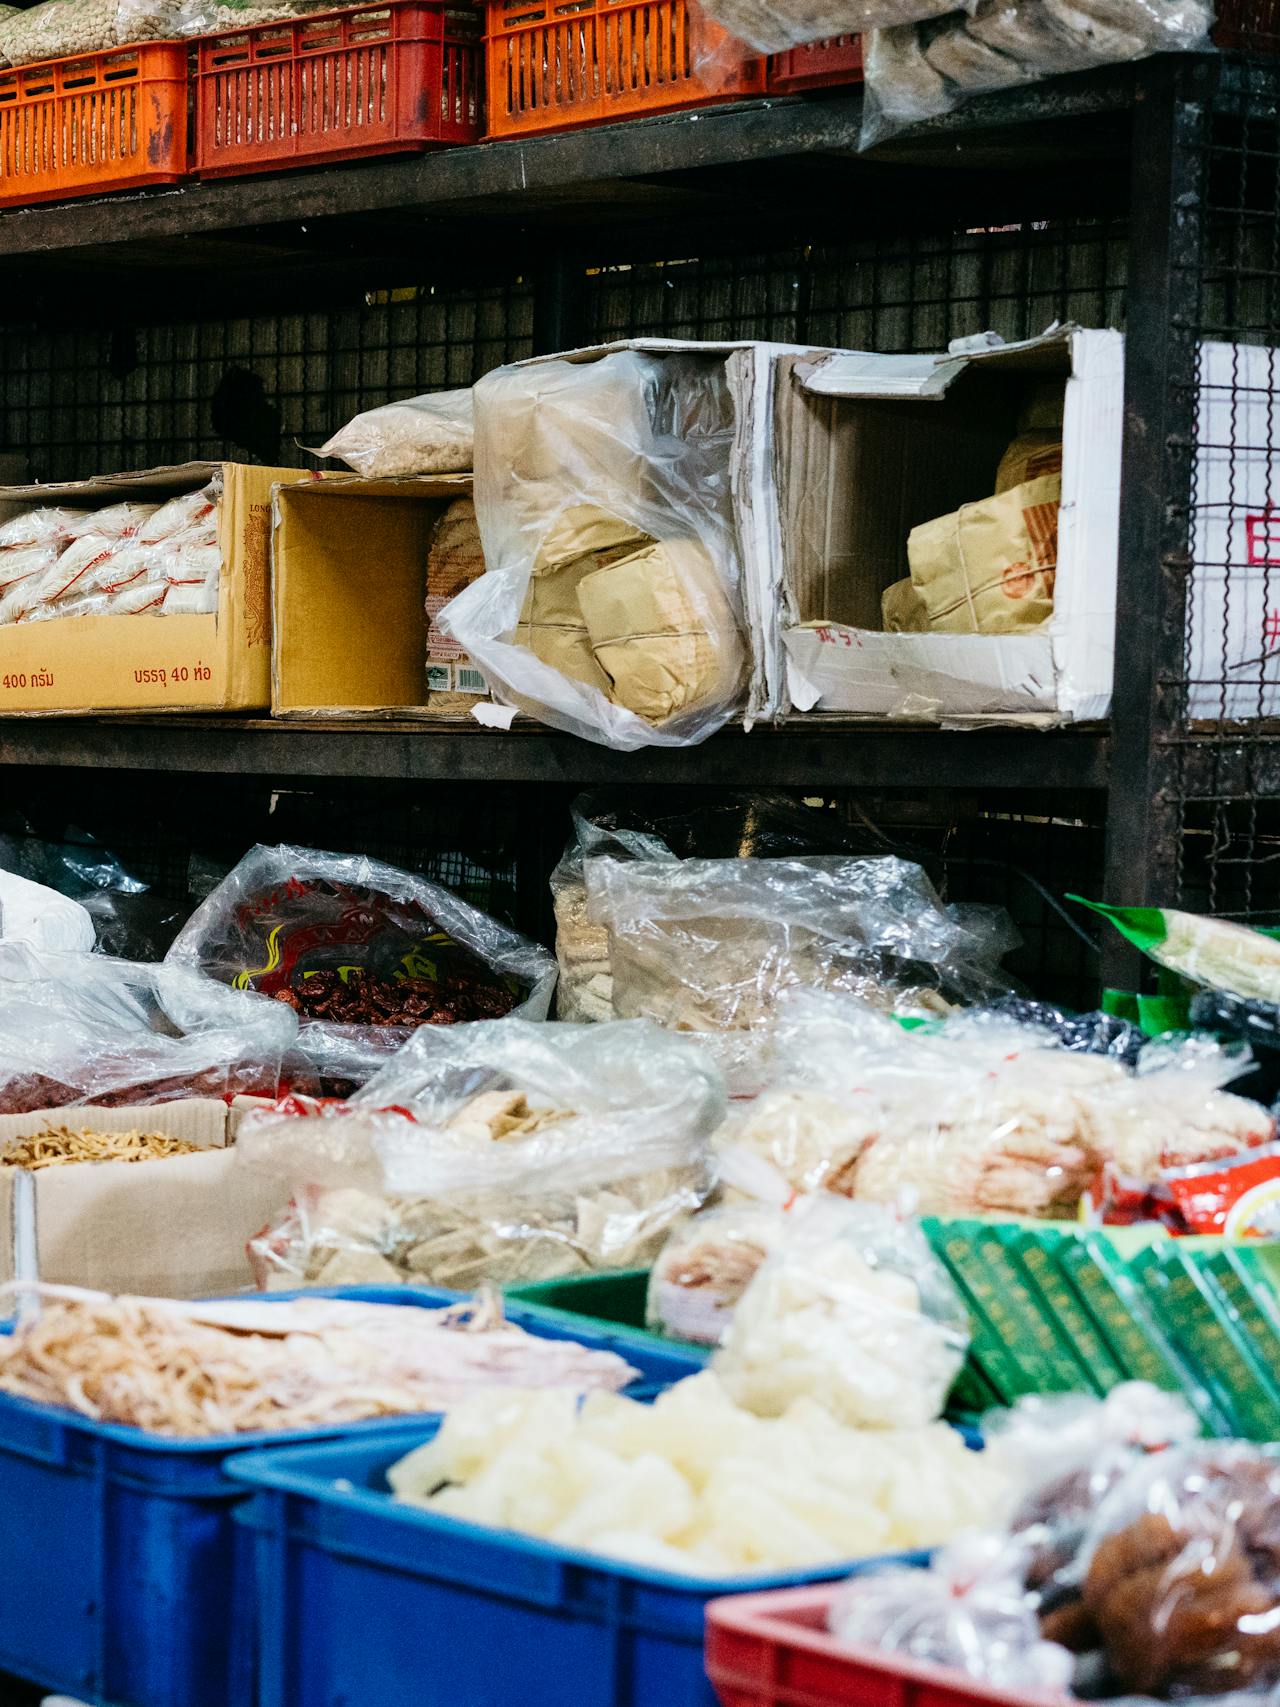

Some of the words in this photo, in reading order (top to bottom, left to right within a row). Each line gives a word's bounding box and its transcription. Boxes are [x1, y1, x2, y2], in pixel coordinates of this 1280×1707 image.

[2, 674, 27, 689] 400
[31, 668, 54, 688] กรัม
[134, 668, 167, 687] บรรจุ
[171, 667, 189, 681] 40
[194, 660, 211, 681] ห่อ
